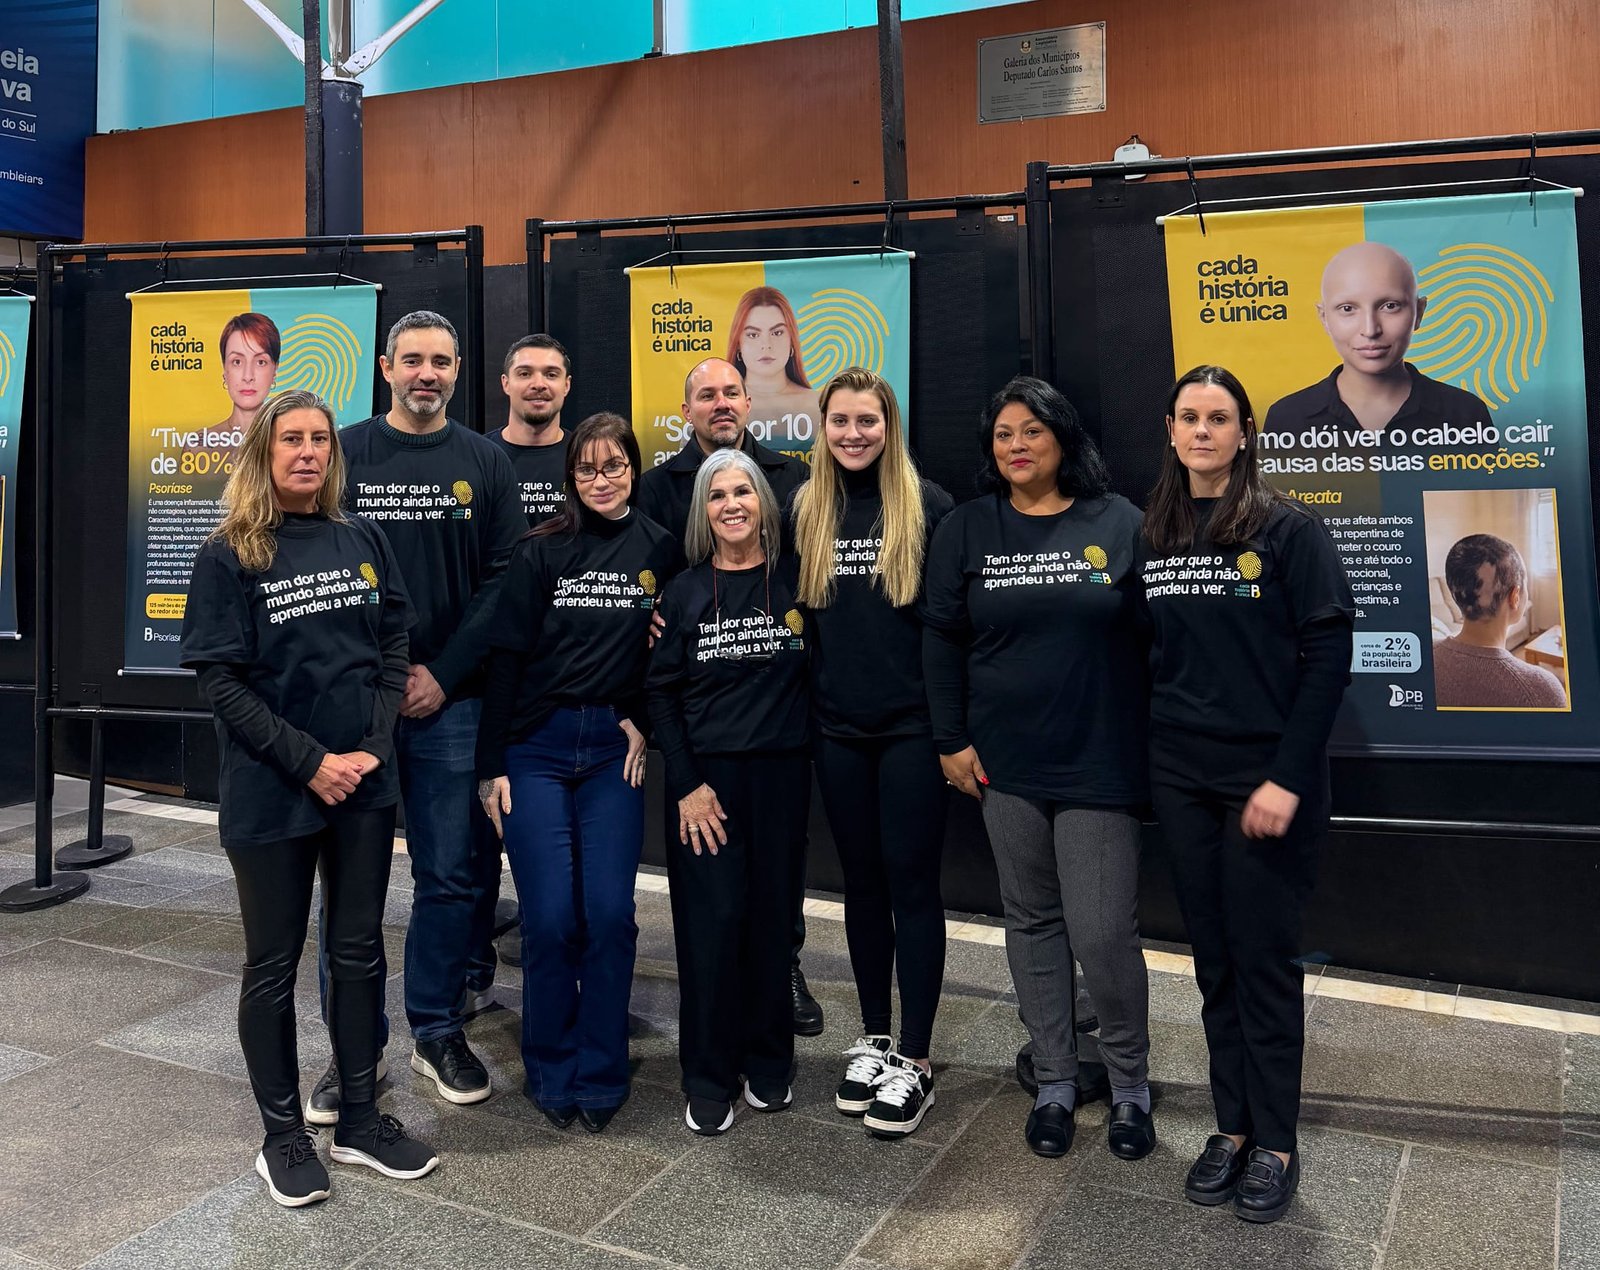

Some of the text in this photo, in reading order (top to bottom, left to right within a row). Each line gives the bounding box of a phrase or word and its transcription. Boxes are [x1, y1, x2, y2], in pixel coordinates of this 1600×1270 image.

[0, 48, 39, 75] eia
[1004, 49, 1080, 69] Galeria dos Municípios
[1003, 64, 1082, 84] Deputado Carlos Santos
[0, 78, 32, 102] va
[2, 117, 36, 134] do Sul
[1197, 254, 1258, 278] cada
[1198, 276, 1289, 301] história
[652, 298, 693, 316] cada
[1200, 299, 1288, 324] é única
[150, 322, 186, 337] cada
[652, 316, 713, 334] história
[150, 338, 204, 354] história
[652, 335, 711, 352] é única
[150, 355, 202, 371] é única
[781, 413, 813, 441] 10
[1300, 425, 1339, 449] dói
[1342, 429, 1386, 448] ver
[1389, 428, 1407, 447] o
[1411, 421, 1500, 446] cabelo
[1504, 418, 1554, 444] cair
[151, 451, 233, 475] de 80%
[1321, 452, 1365, 473] das
[1368, 454, 1424, 472] suas
[149, 482, 192, 494] Psoríase
[357, 482, 440, 496] Tem dor que o
[523, 482, 552, 492] que o
[357, 494, 457, 507] mundo ainda não
[547, 491, 567, 502] não
[414, 512, 423, 520] a
[425, 511, 446, 520] ver.
[529, 505, 535, 513] a
[537, 504, 557, 513] ver.
[1332, 517, 1351, 527] que
[1352, 515, 1377, 525] afeta
[1379, 515, 1413, 525] ambos
[1344, 528, 1389, 540] repentina
[1391, 528, 1404, 538] de
[852, 539, 882, 551] que o
[1364, 543, 1401, 551] o couro
[845, 550, 876, 562] ainda
[984, 551, 1071, 566] Tem dor que o
[1165, 556, 1186, 567] dor
[1187, 556, 1212, 568] que
[1214, 556, 1223, 565] o
[1364, 554, 1379, 564] até
[1381, 554, 1404, 564] todo
[982, 560, 1092, 575] mundo ainda não
[1178, 568, 1241, 580] ainda não
[260, 568, 351, 594] Tem dor que o
[598, 572, 628, 584] que o
[984, 574, 1043, 591] aprendeu
[1045, 575, 1054, 583] a
[1056, 573, 1082, 583] ver.
[266, 578, 370, 609] mundo ainda não
[591, 583, 621, 595] ainda
[623, 584, 644, 595] não
[1192, 585, 1200, 594] a
[1202, 585, 1226, 595] ver.
[1351, 581, 1402, 593] crianças e
[269, 599, 331, 624] aprendeu
[333, 599, 341, 609] a
[343, 594, 365, 606] ver.
[605, 599, 612, 607] a
[614, 598, 635, 608] ver.
[698, 623, 718, 635] Tem
[721, 618, 740, 630] dor
[742, 616, 764, 629] que
[737, 627, 769, 640] ainda
[771, 625, 792, 637] não
[144, 627, 153, 641] B
[753, 644, 761, 653] a
[1384, 638, 1410, 650] 2%
[1362, 658, 1412, 668] brasileira
